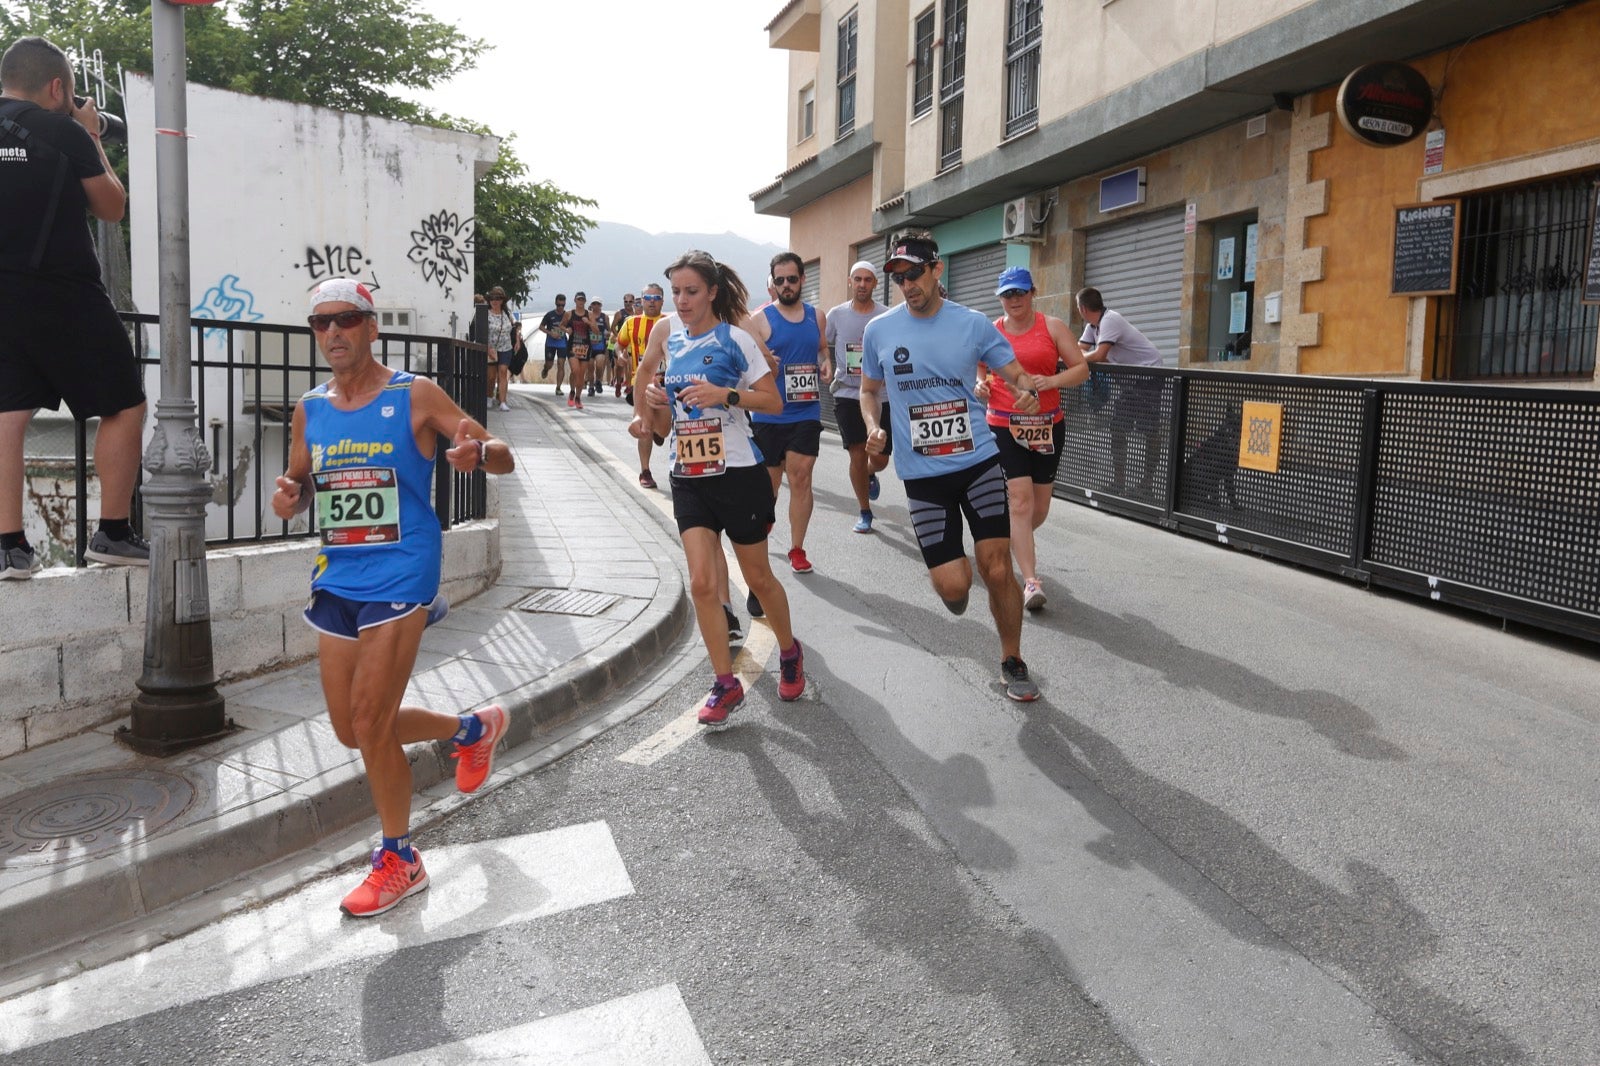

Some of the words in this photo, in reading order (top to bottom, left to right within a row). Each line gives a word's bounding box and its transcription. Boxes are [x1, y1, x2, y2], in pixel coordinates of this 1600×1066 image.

[918, 416, 967, 439] 3073
[1016, 428, 1050, 442] 2026
[326, 439, 394, 457] olimpo
[679, 437, 721, 458] 2115
[325, 456, 368, 467] deportes
[330, 492, 384, 522] 520
